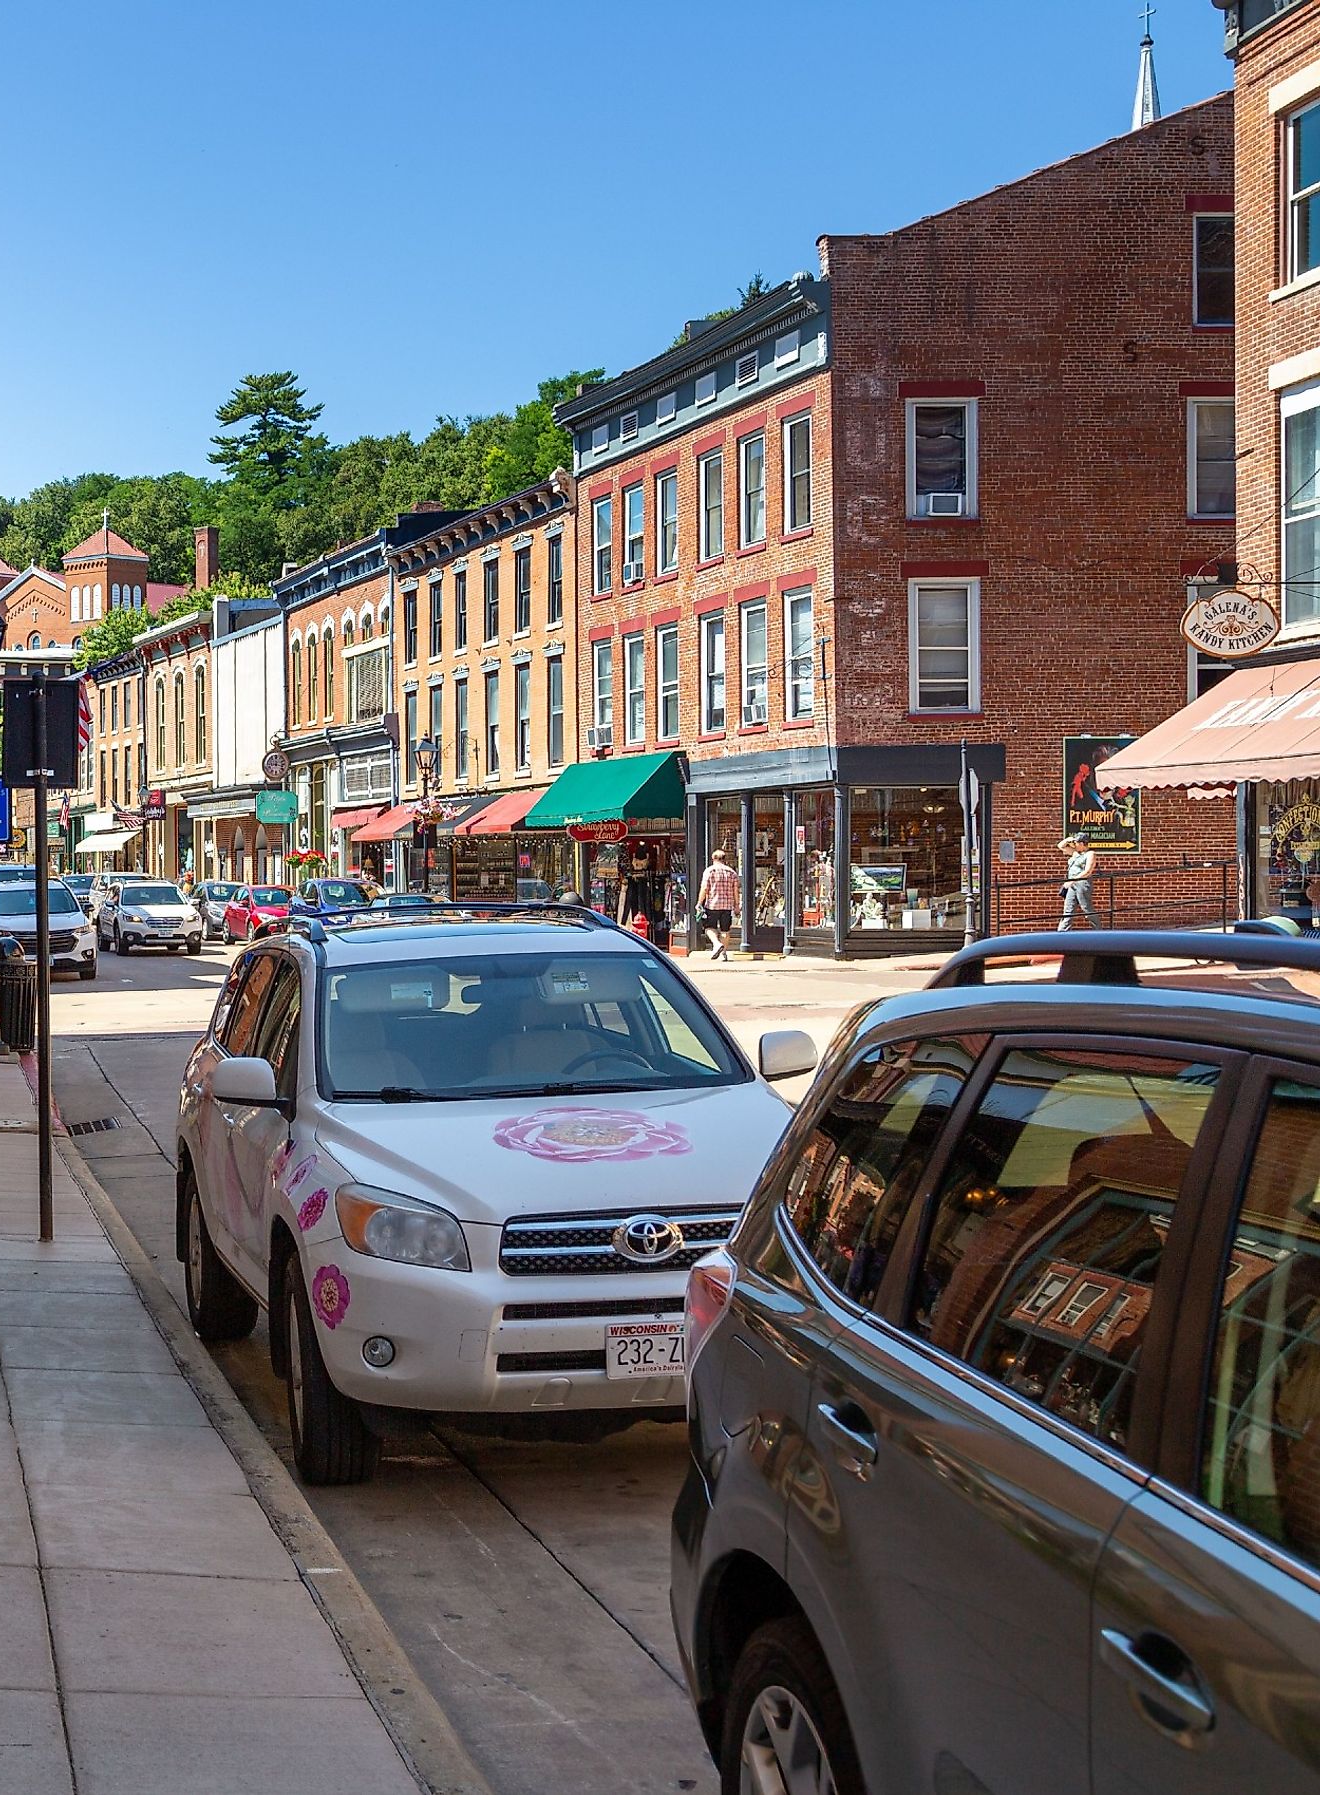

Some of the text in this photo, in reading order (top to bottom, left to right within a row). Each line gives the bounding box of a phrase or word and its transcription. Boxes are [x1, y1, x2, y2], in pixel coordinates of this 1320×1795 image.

[1204, 602, 1258, 621] GALENA'S
[1190, 622, 1274, 650] KANDY KITCHEN
[610, 1325, 667, 1336] WISCONSIN
